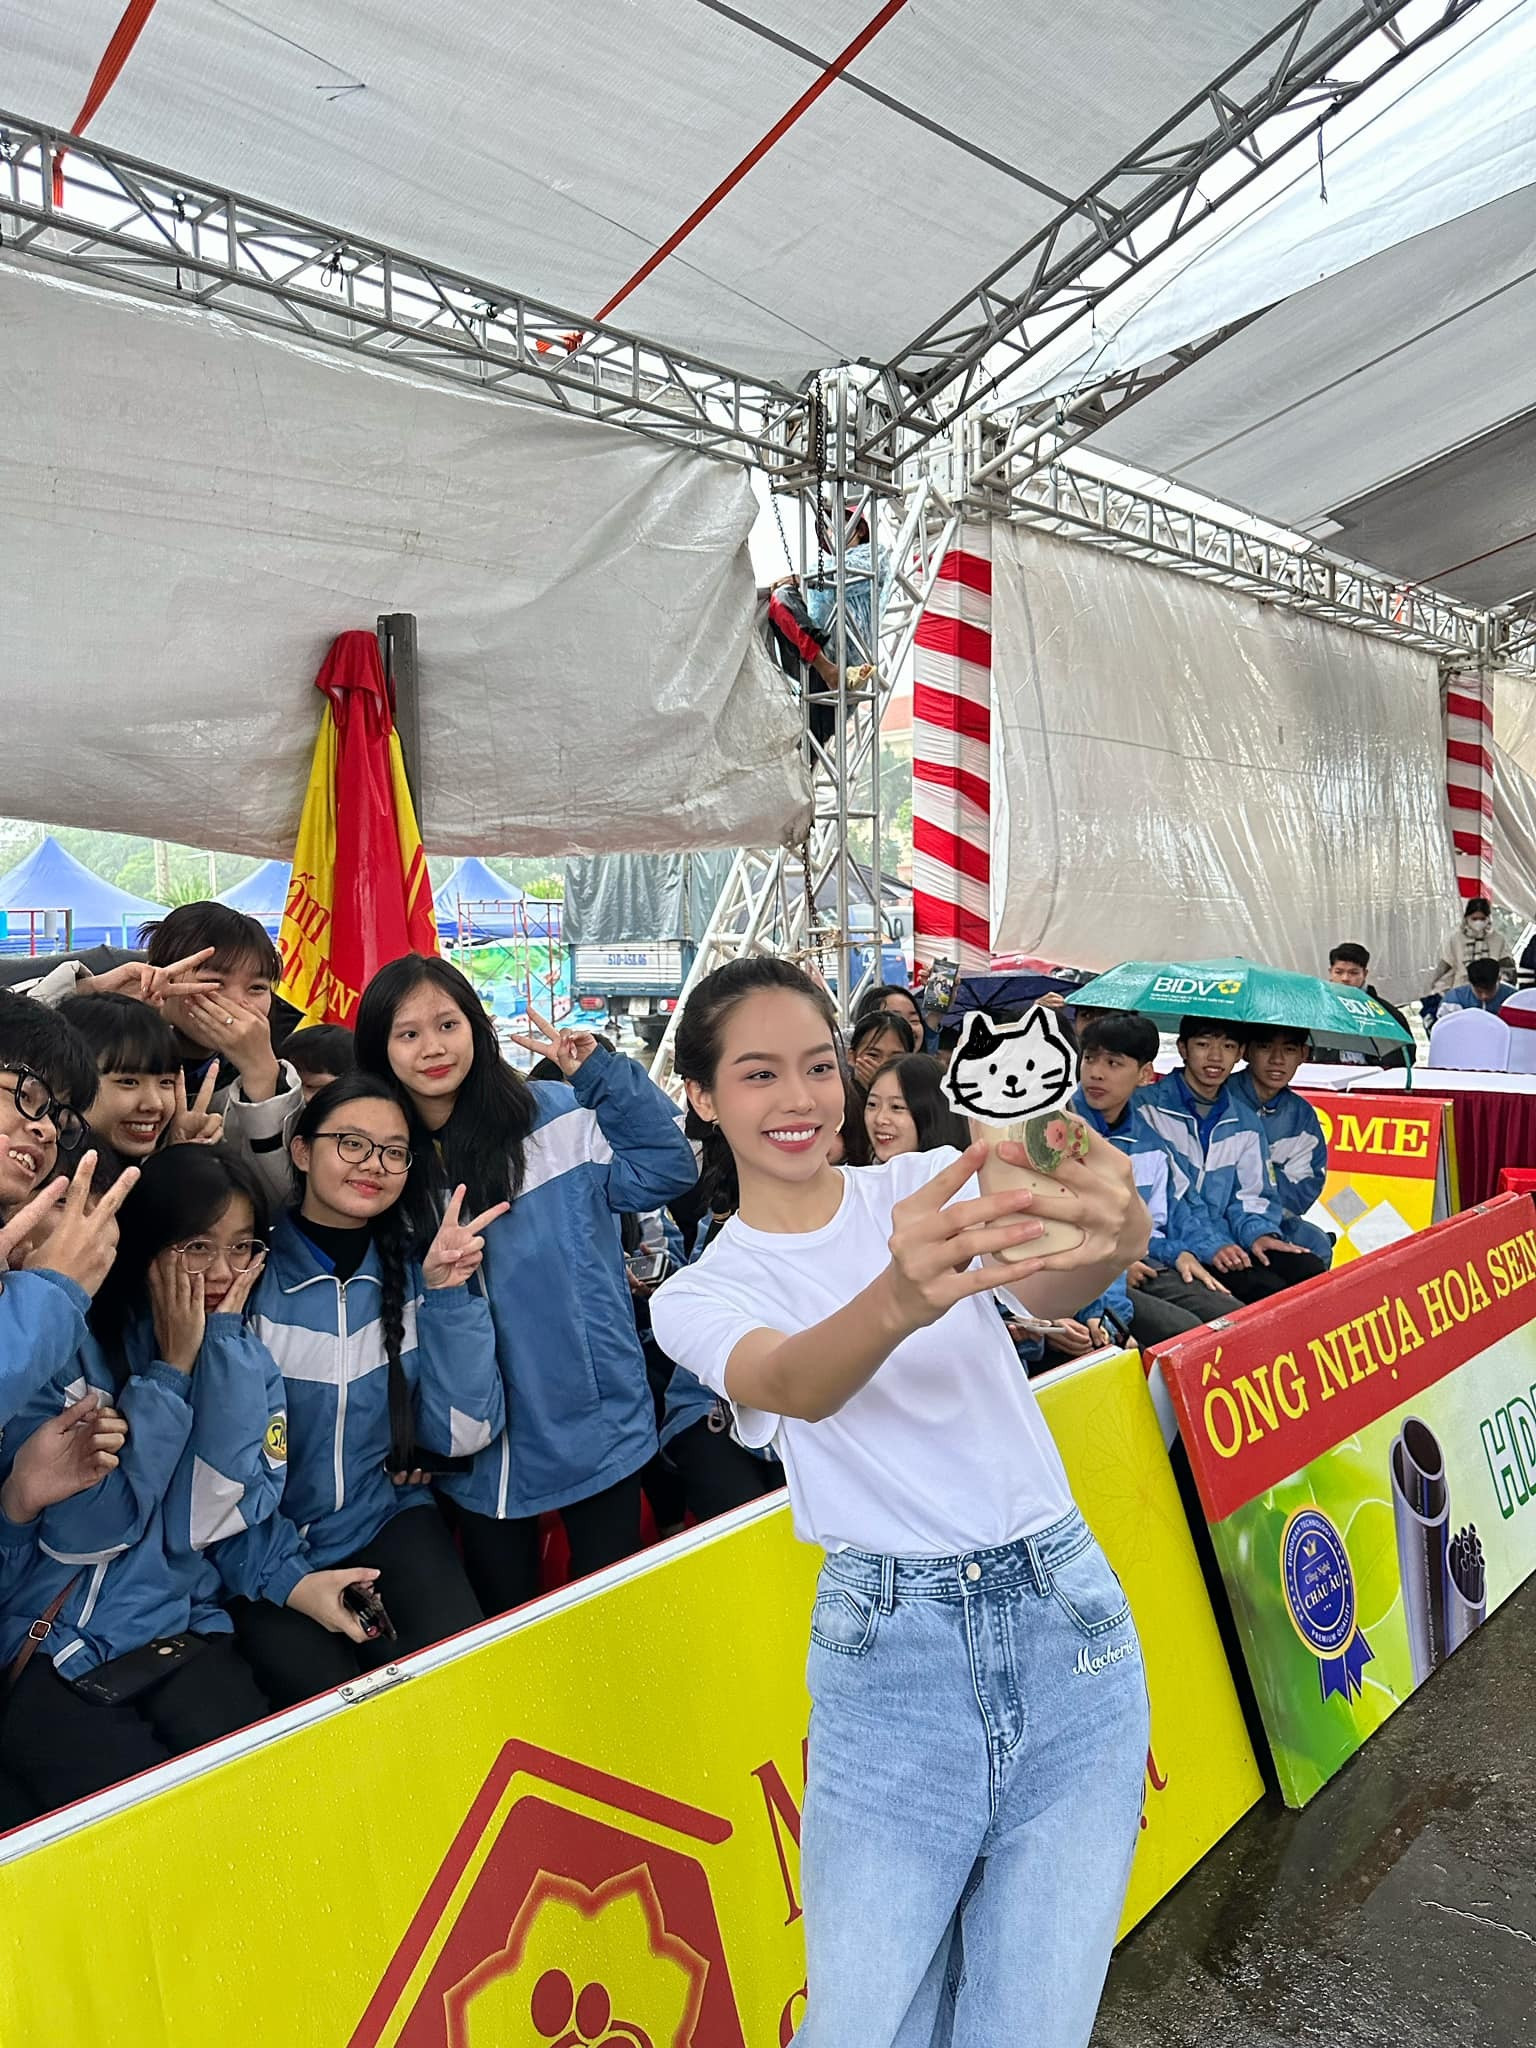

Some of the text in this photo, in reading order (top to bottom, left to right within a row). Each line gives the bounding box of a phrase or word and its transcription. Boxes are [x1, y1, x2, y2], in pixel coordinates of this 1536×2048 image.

[1152, 976, 1220, 996] BIDV
[1202, 1229, 1536, 1459] ỐNG NHỰA HOA SEN
[1479, 1382, 1536, 1520] HD
[1288, 1519, 1332, 1566] EUROPEAN TECHNOLOGY
[1304, 1572, 1342, 1610] CHÂU ÂU
[1311, 1602, 1352, 1644] PREMIUM QUALITY
